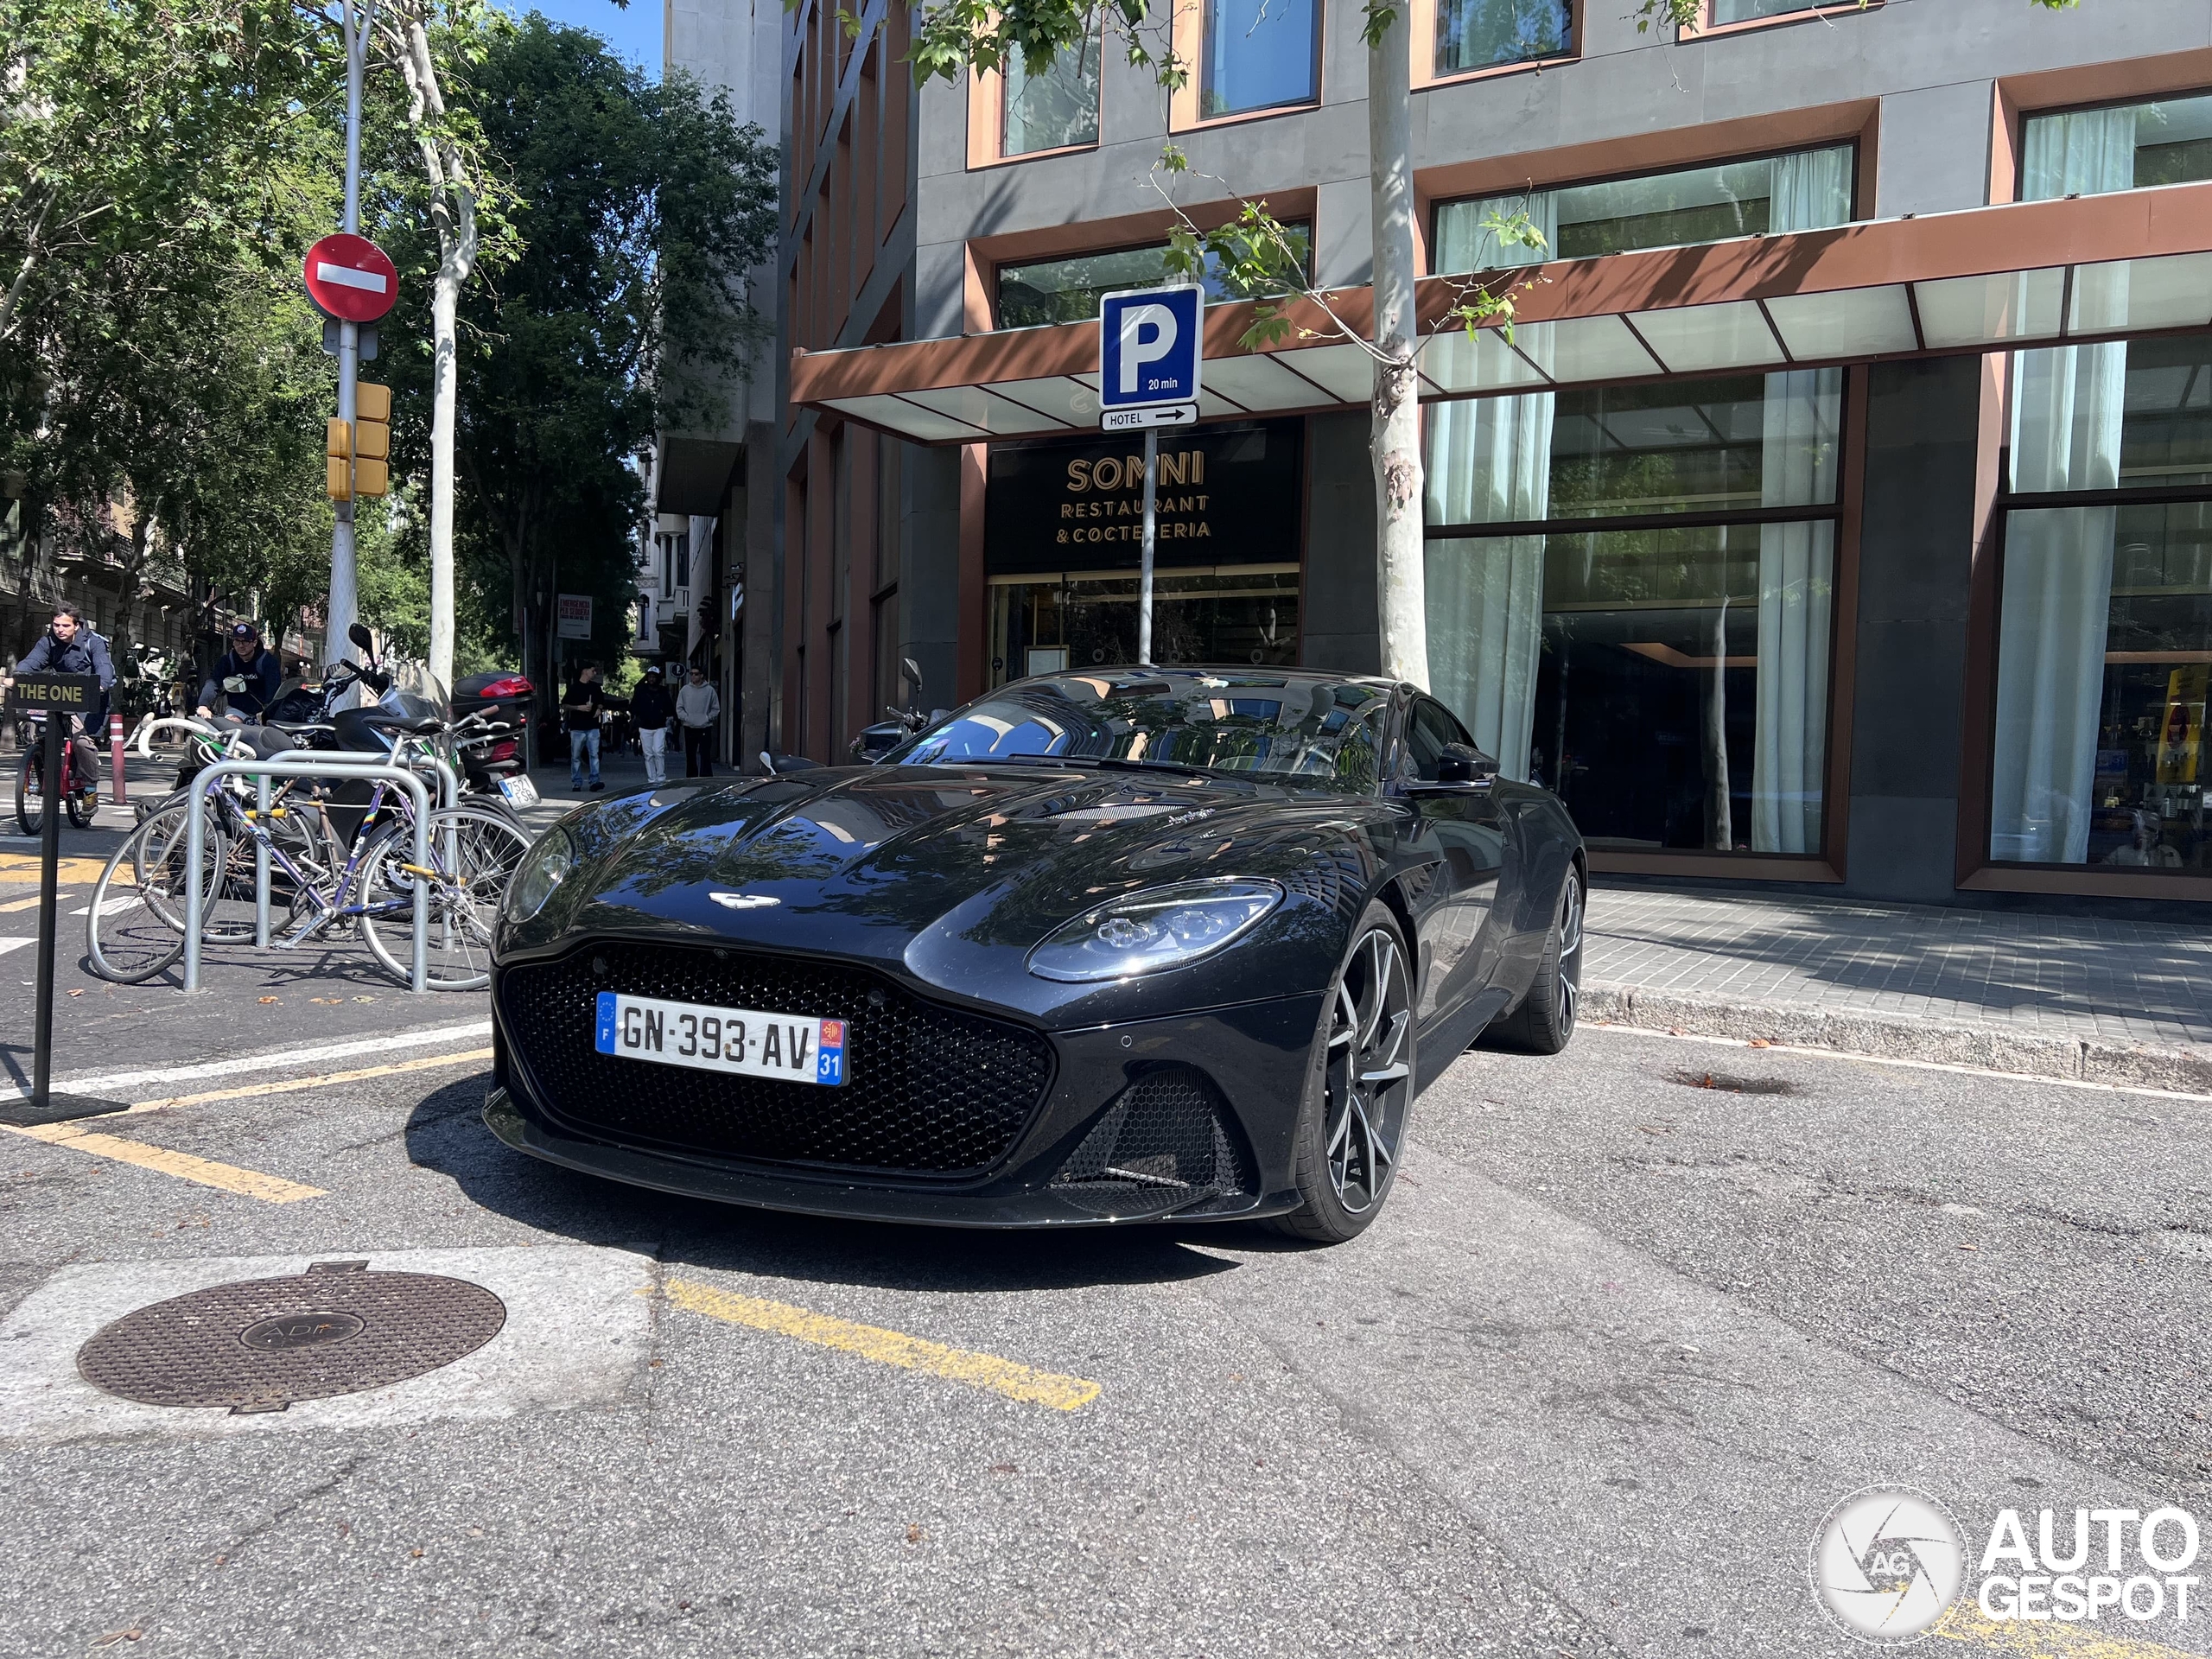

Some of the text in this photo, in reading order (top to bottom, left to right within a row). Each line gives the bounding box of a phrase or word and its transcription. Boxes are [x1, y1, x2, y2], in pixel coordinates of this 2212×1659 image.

[1120, 303, 1178, 393] P
[1148, 377, 1178, 391] 20 min
[1110, 412, 1142, 426] HOTEL
[1066, 450, 1205, 493] SOMNI
[1056, 521, 1211, 544] &COCTEERIA
[17, 683, 82, 702] THE ONE
[515, 789, 534, 804] FSB
[602, 1028, 609, 1041] F
[623, 1006, 810, 1070] GN-393-AV
[819, 1053, 840, 1077] 31
